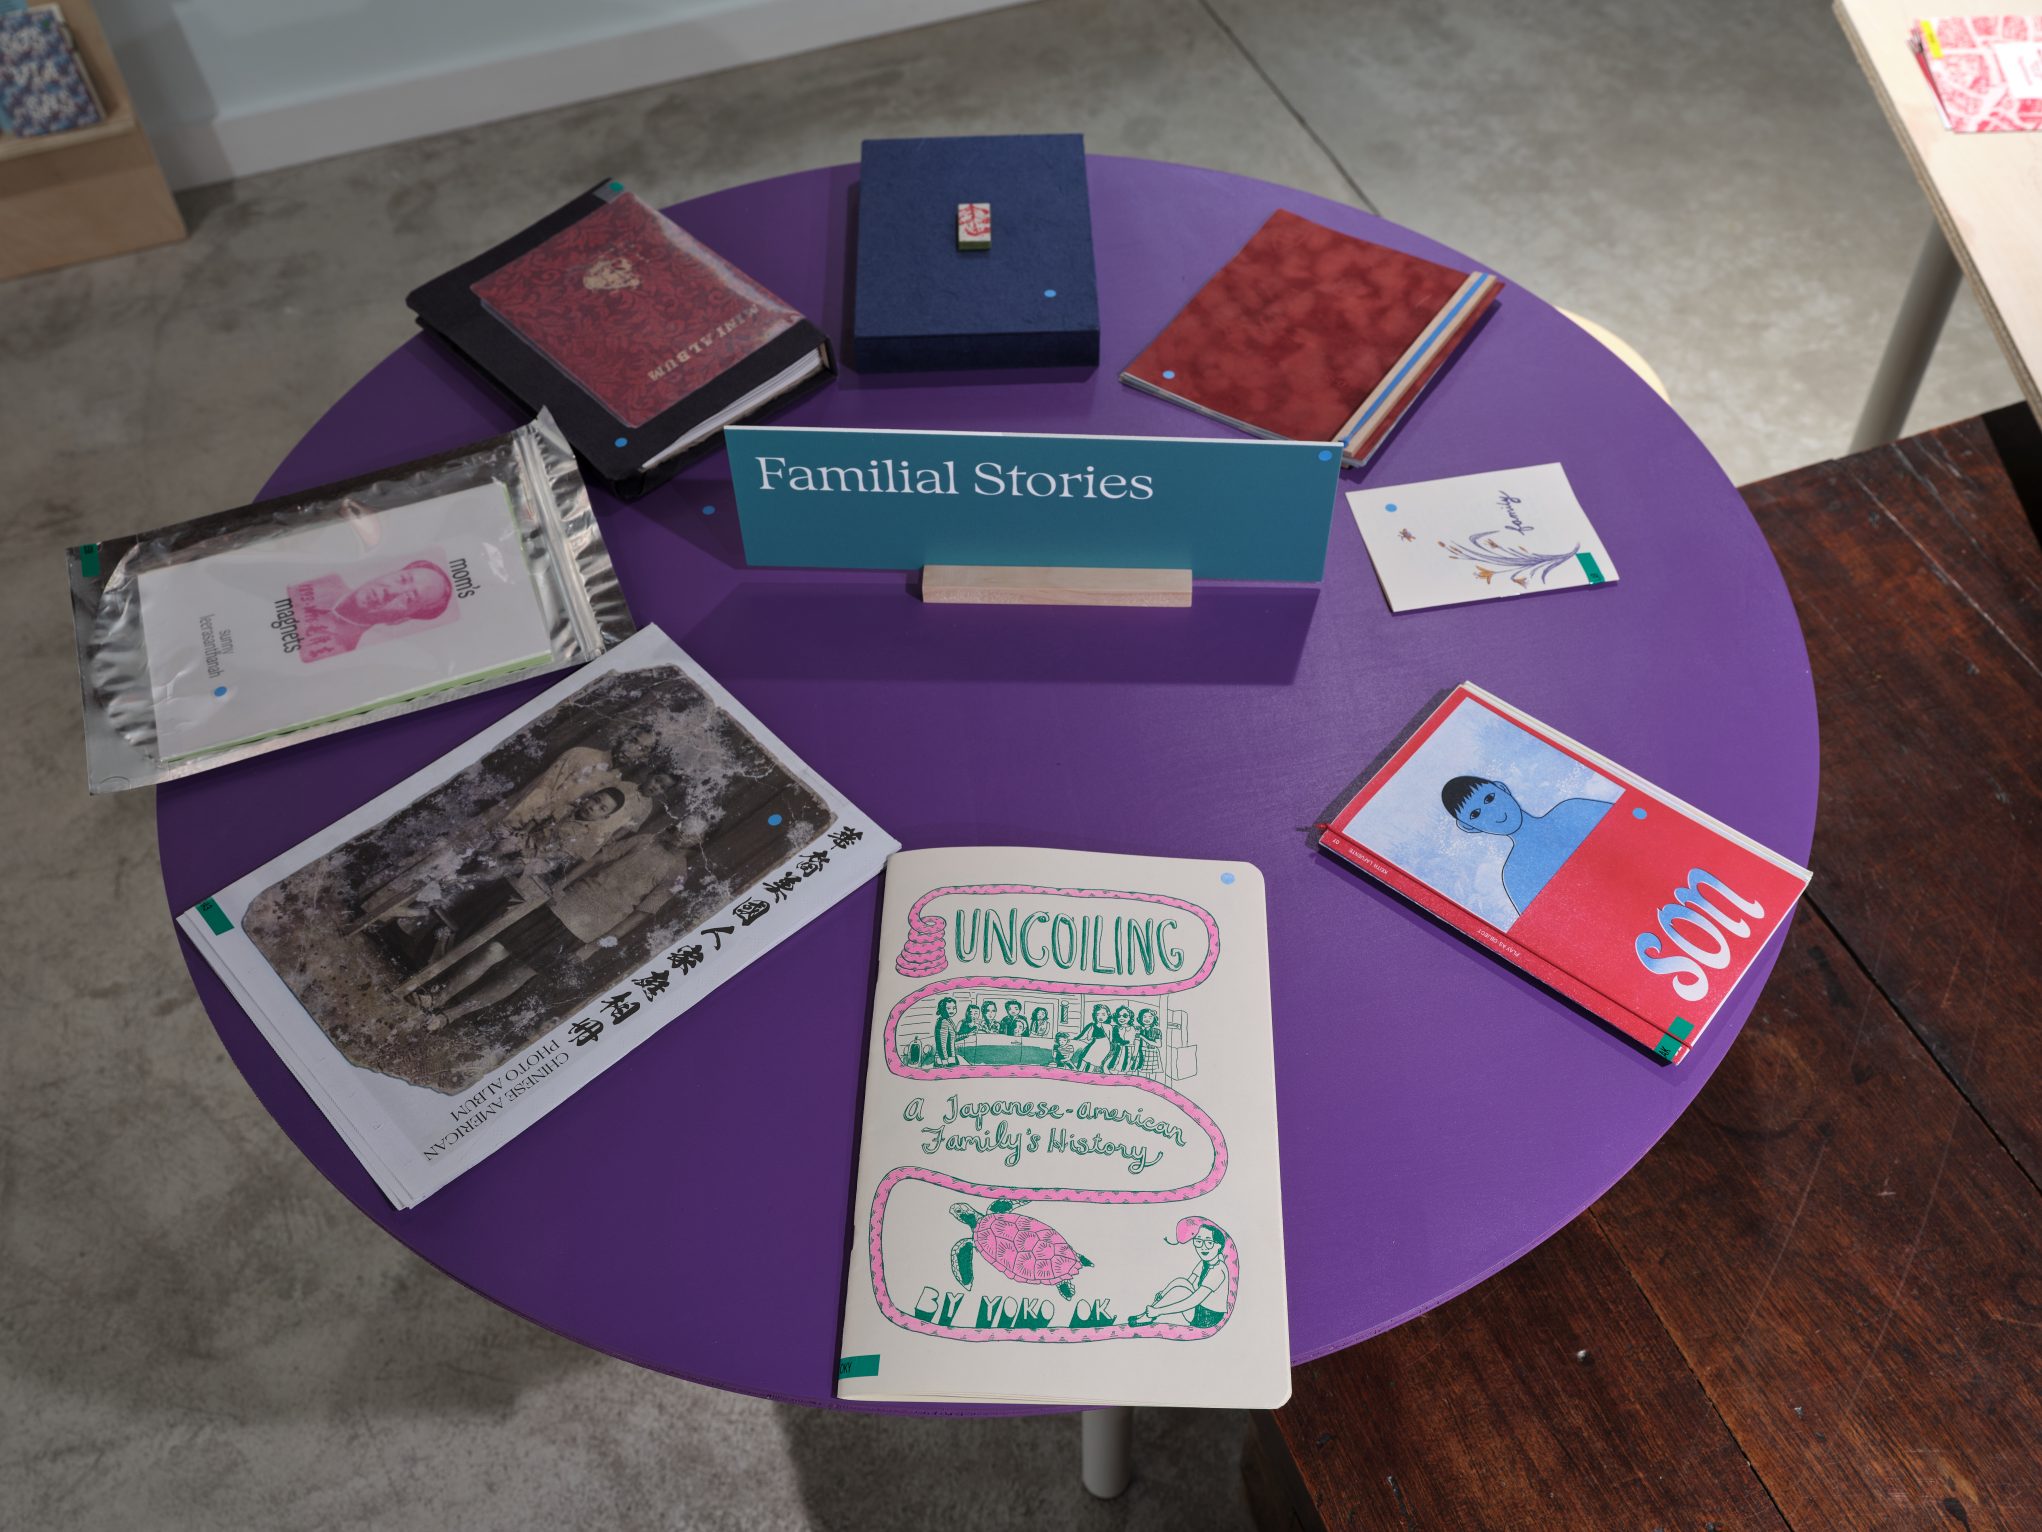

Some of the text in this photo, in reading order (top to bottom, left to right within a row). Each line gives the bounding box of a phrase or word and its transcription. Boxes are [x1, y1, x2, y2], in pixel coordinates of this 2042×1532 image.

[647, 333, 714, 382] ALBUM
[755, 456, 1154, 501] Familial Stories
[1497, 489, 1535, 536] family
[449, 557, 481, 600] mom's
[216, 628, 235, 655] sunny
[271, 597, 305, 654] magnets
[955, 907, 1185, 975] UNCOILING
[1634, 867, 1765, 1002] son
[422, 1051, 570, 1162] CHINESE AMERICAN
[449, 1039, 561, 1122] PHOTO ALBUM
[920, 1119, 1164, 1175] Family's History
[915, 1286, 965, 1326] BY
[976, 1295, 1056, 1328] YOKO
